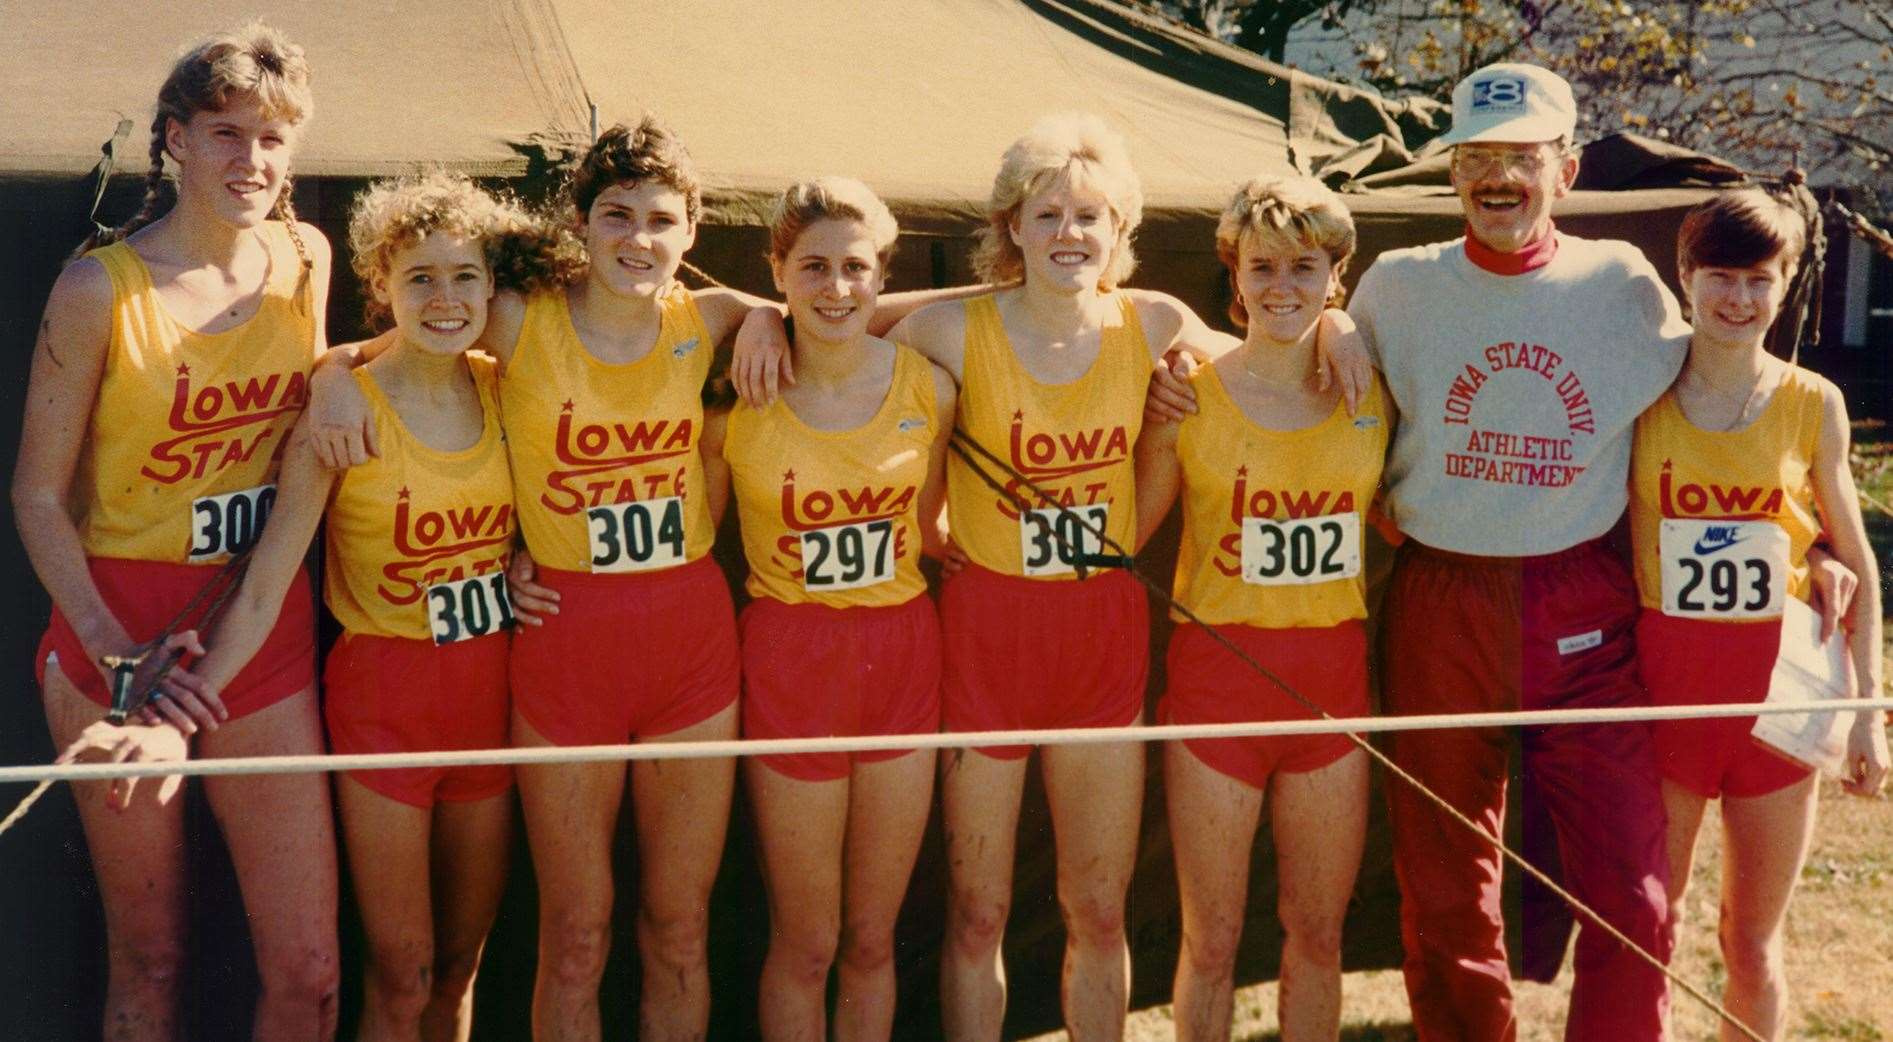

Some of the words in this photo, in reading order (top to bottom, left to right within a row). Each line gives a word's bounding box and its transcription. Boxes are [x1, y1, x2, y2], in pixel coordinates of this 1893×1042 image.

[1487, 79, 1522, 105] 8
[1444, 363, 1488, 425] IOWA
[1485, 341, 1562, 381] STATE
[1556, 370, 1595, 436] UNIV.
[1466, 429, 1573, 461] ATHLETIC
[996, 476, 1115, 521] STAT
[588, 499, 685, 567] 304
[803, 520, 893, 585] 297
[1258, 521, 1345, 578] 302
[1703, 526, 1741, 543] NIKE
[428, 572, 516, 645] 301
[1677, 557, 1771, 612] 293
